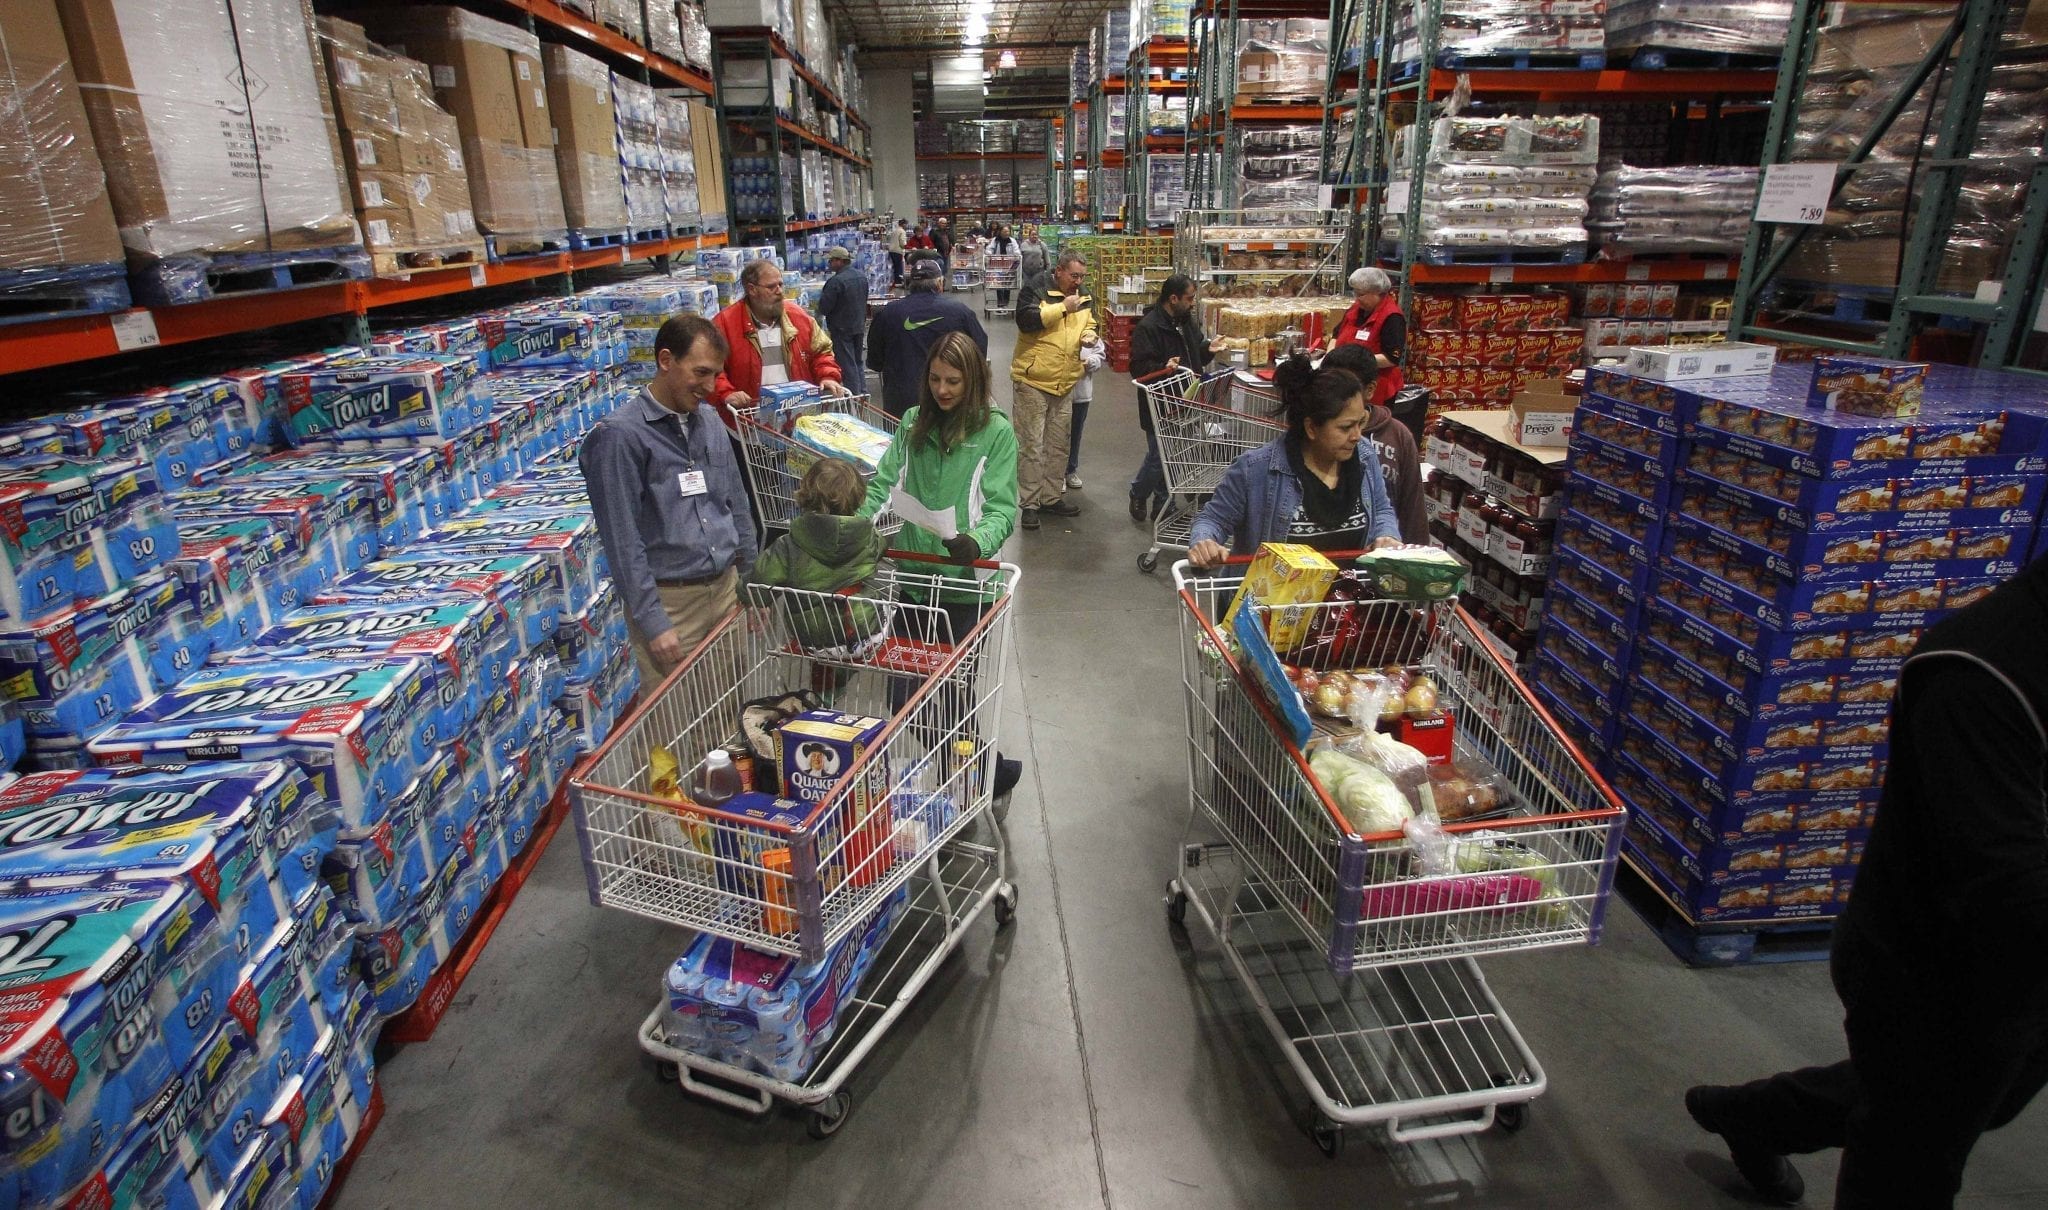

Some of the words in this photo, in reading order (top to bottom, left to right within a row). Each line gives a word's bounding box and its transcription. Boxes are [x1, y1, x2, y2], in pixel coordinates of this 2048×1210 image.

[1800, 207, 1823, 220] 7.89
[1468, 304, 1486, 318] Stove
[1485, 302, 1498, 313] Top
[1502, 304, 1521, 317] Stove
[1519, 302, 1531, 312] Top
[513, 328, 555, 359] Towel
[1484, 339, 1505, 351] Stove
[1504, 337, 1517, 349] Top
[1518, 339, 1539, 351] Stove
[1538, 336, 1550, 348] Top
[1551, 339, 1572, 351] Stove
[1570, 336, 1583, 347] Top
[1480, 373, 1501, 385] Stove
[1499, 371, 1512, 382] Top
[1825, 375, 1856, 388] Onion
[323, 384, 390, 429] Towel
[780, 393, 804, 409] Ziploc
[308, 423, 320, 434] 12
[419, 417, 431, 427] 80
[1657, 415, 1664, 428] 6
[1524, 424, 1555, 435] Prego
[228, 435, 242, 450] 80
[1923, 439, 1951, 454] Onion
[1644, 460, 1651, 473] 6
[1791, 457, 1801, 470] 6
[1801, 464, 1821, 477] BOXES
[1912, 467, 1932, 475] Soup
[1940, 467, 1953, 476] Dip
[1954, 466, 1967, 475] Mix
[2014, 457, 2025, 471] 6
[2025, 463, 2047, 471] BOXES
[482, 472, 492, 485] 80
[58, 486, 92, 499] KIRKLAND
[1907, 492, 1936, 507] Onion
[1980, 490, 2009, 505] Onion
[1778, 507, 1787, 520] 6
[1904, 511, 1925, 519] Onion
[1926, 511, 1951, 519] Recipe
[2000, 509, 2011, 523] 6
[440, 519, 560, 542] Towel
[1897, 519, 1917, 527] Soup
[1925, 519, 1938, 528] Dip
[1938, 518, 1951, 526] Mix
[130, 537, 155, 560] 80
[358, 543, 370, 559] 80
[1966, 541, 1993, 557] Onion
[1766, 556, 1775, 569] 6
[1985, 561, 1996, 575] 6
[1911, 570, 1923, 579] Dip
[38, 576, 60, 600] 12
[281, 588, 297, 606] 80
[109, 598, 151, 643] Towel
[279, 608, 439, 644] Towel
[541, 614, 552, 631] 80
[34, 619, 75, 638] KIRKLAND
[158, 671, 356, 723] Towel
[95, 693, 114, 717] 12
[1413, 718, 1445, 727] KIRKLAND
[189, 728, 254, 739] KIRKLAND
[422, 723, 436, 747] 80
[113, 752, 132, 764] Most
[187, 745, 239, 756] KIRKLAND
[0, 779, 224, 844] Towel
[513, 826, 526, 844] 80
[158, 844, 190, 856] 80
[97, 897, 125, 912] 12
[420, 881, 445, 925] Towel
[102, 945, 139, 983] KIRKLAND
[757, 972, 774, 986] 36
[185, 987, 213, 1030] 80
[277, 1046, 294, 1080] 12
[146, 1078, 184, 1123] KIRKLAND
[4, 1088, 46, 1140] el
[150, 1069, 202, 1156] Towel
[316, 1151, 330, 1184] 12
